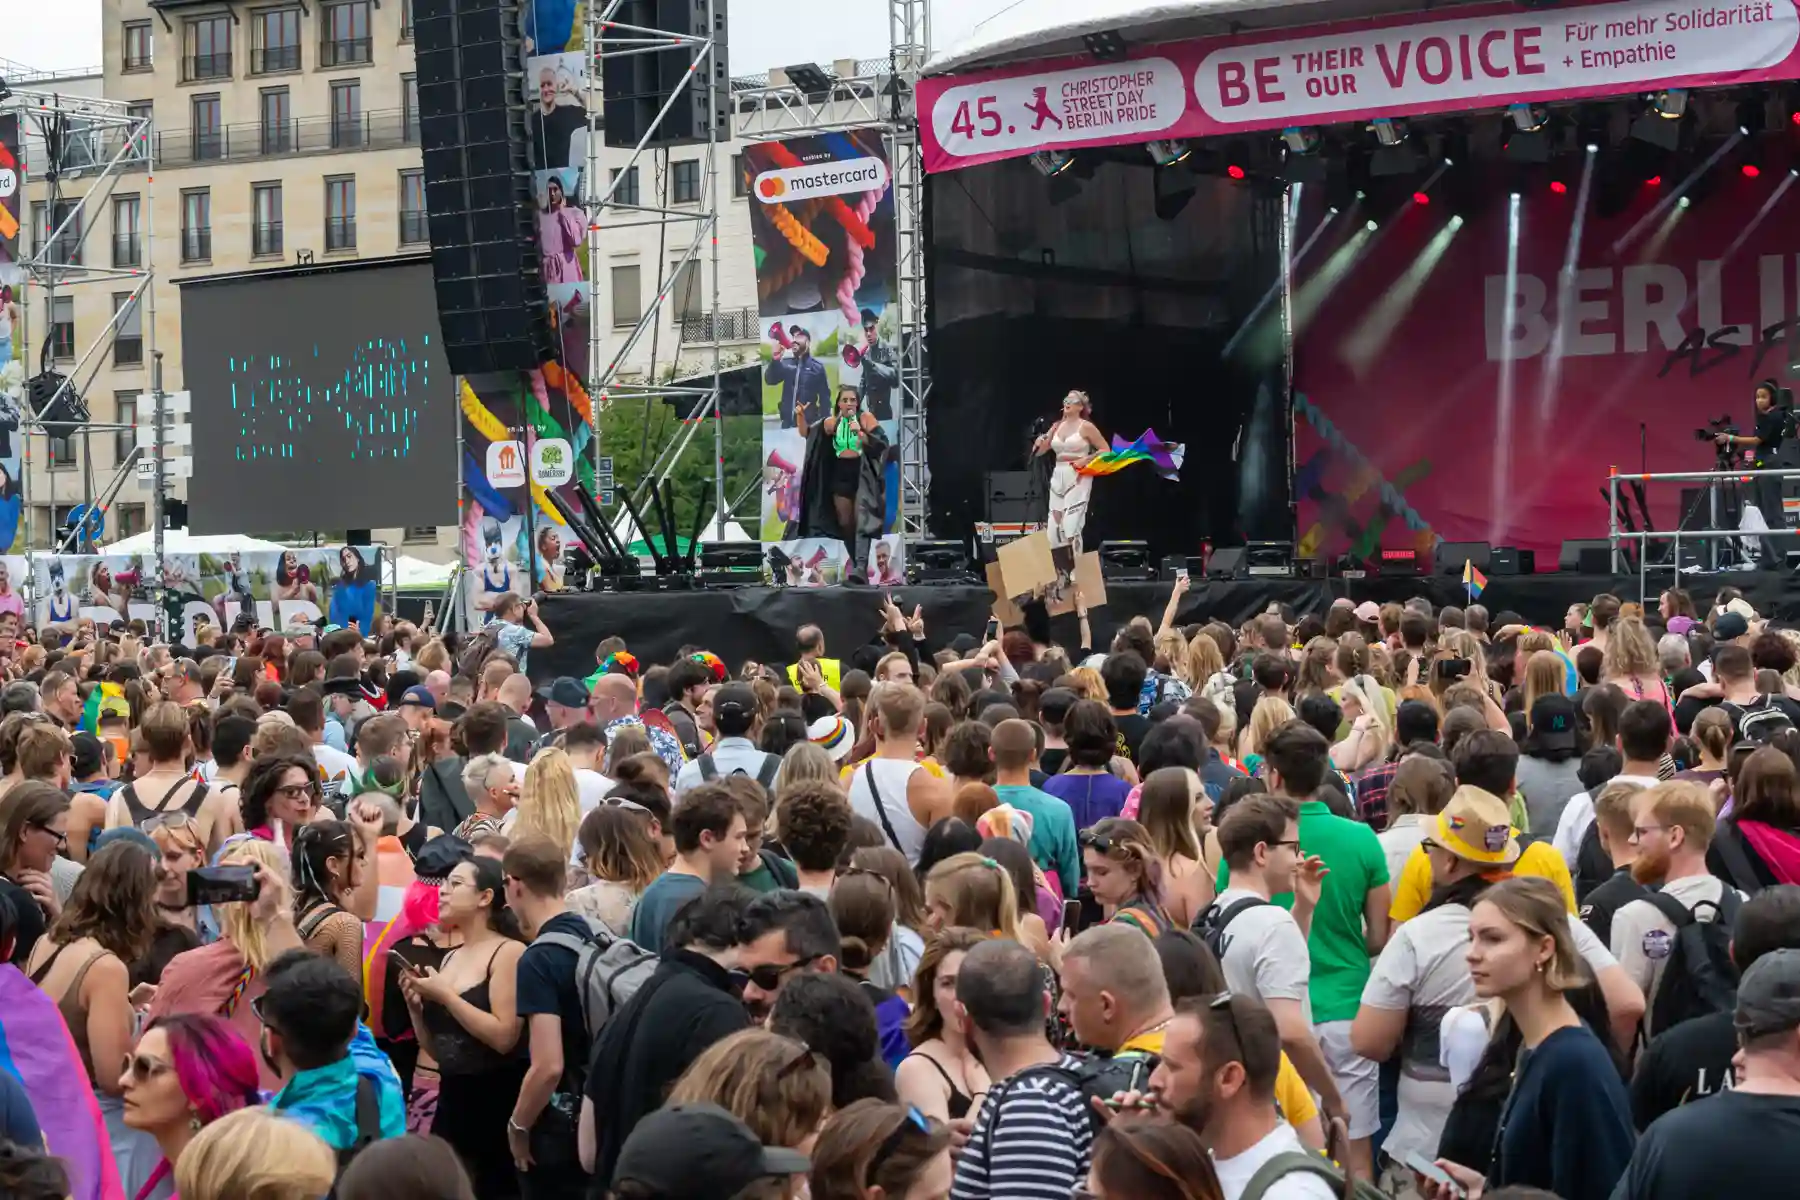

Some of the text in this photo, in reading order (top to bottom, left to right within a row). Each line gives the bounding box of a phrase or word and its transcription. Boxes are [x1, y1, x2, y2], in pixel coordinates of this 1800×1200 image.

[1564, 0, 1774, 43] Für mehr Solidarität
[1292, 46, 1365, 74] THEIR
[1375, 26, 1546, 89] VOICE
[1580, 40, 1677, 70] Empathie
[1061, 70, 1155, 98] CHRISTOPHER
[1217, 56, 1286, 109] BE
[1306, 73, 1358, 99] OUR
[1062, 89, 1145, 114] STREET DAY
[951, 95, 1016, 140] 45.
[1066, 103, 1158, 130] BERLIN PRIDE
[790, 164, 878, 191] mastercard
[1484, 252, 1800, 362] BERLI
